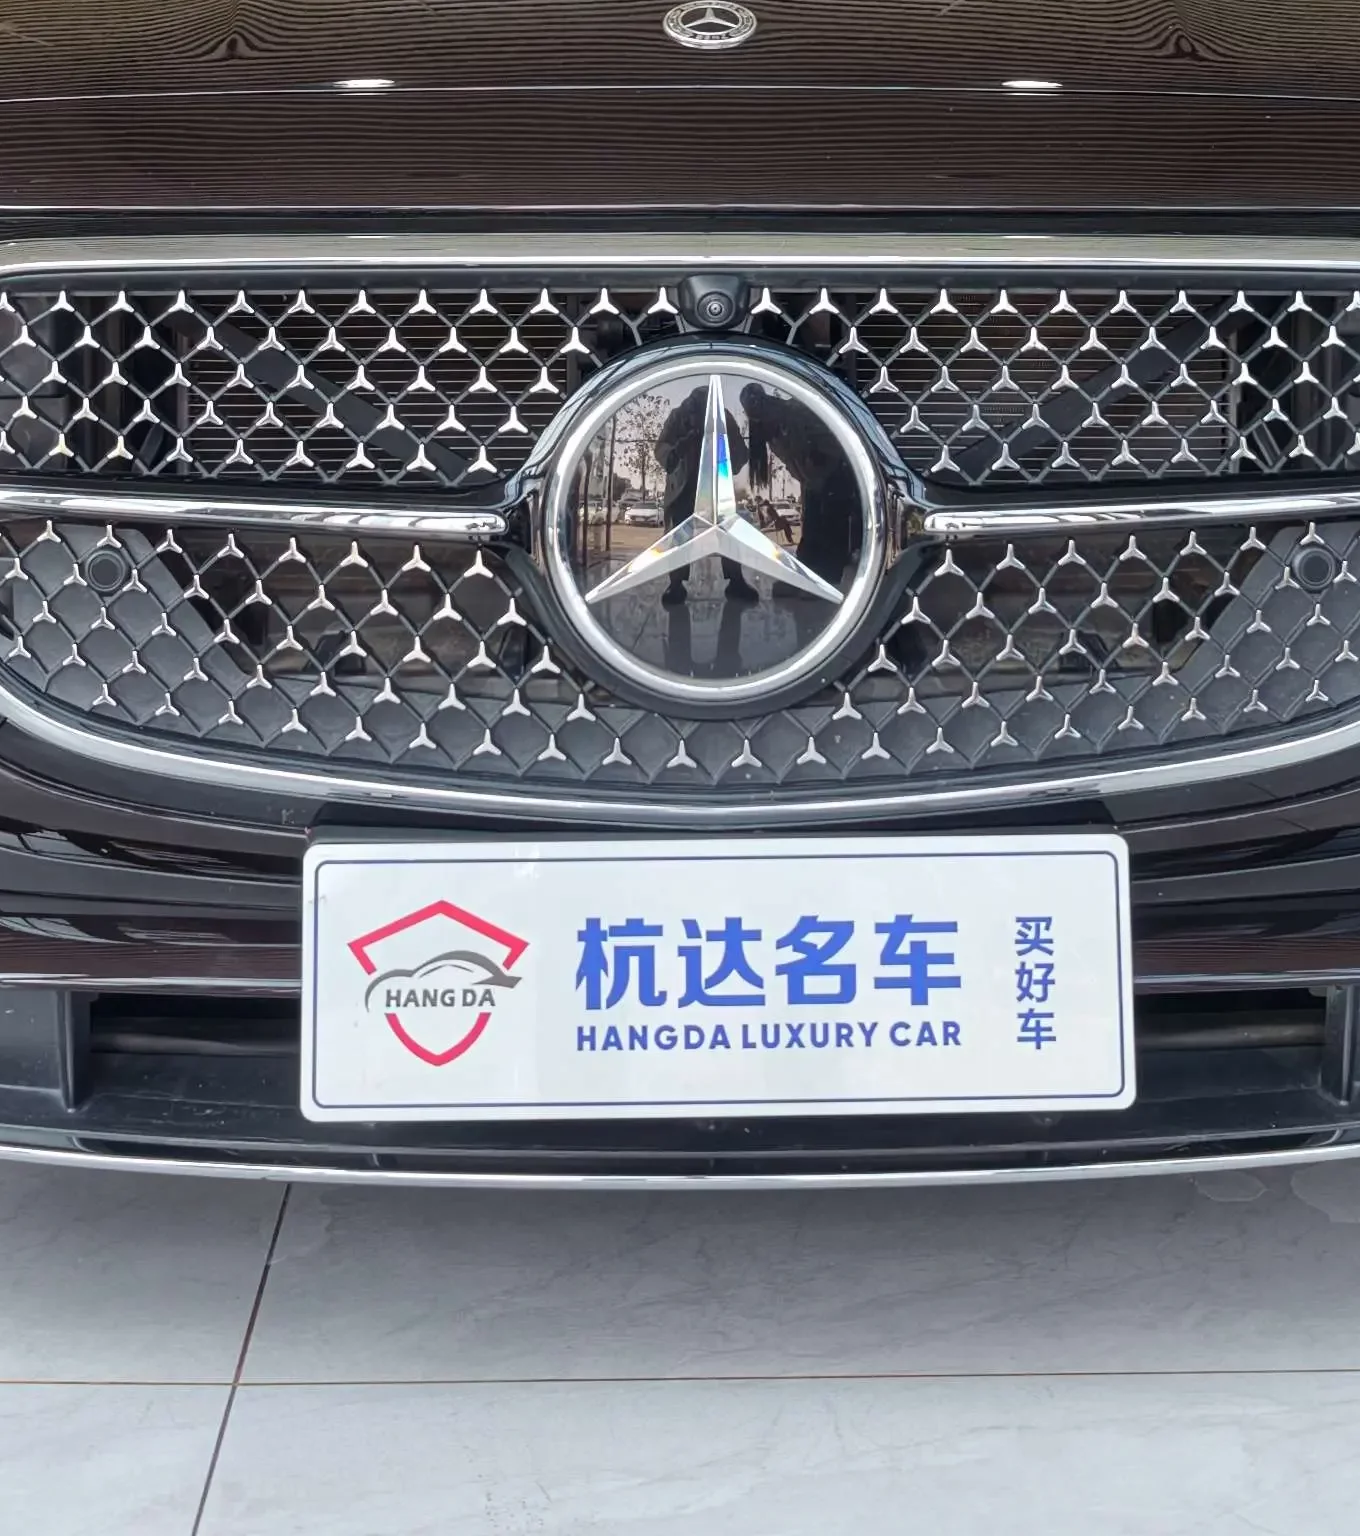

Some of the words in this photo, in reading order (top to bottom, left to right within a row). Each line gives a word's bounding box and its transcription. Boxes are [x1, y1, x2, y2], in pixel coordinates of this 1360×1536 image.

[575, 914, 962, 1011] 杭达名车
[1016, 916, 1057, 1049] 买好车
[385, 988, 455, 1008] HANG
[461, 988, 497, 1007] DA
[576, 1025, 730, 1051] HANGDA
[742, 1023, 876, 1050] LUXURY
[890, 1020, 962, 1047] CAR
